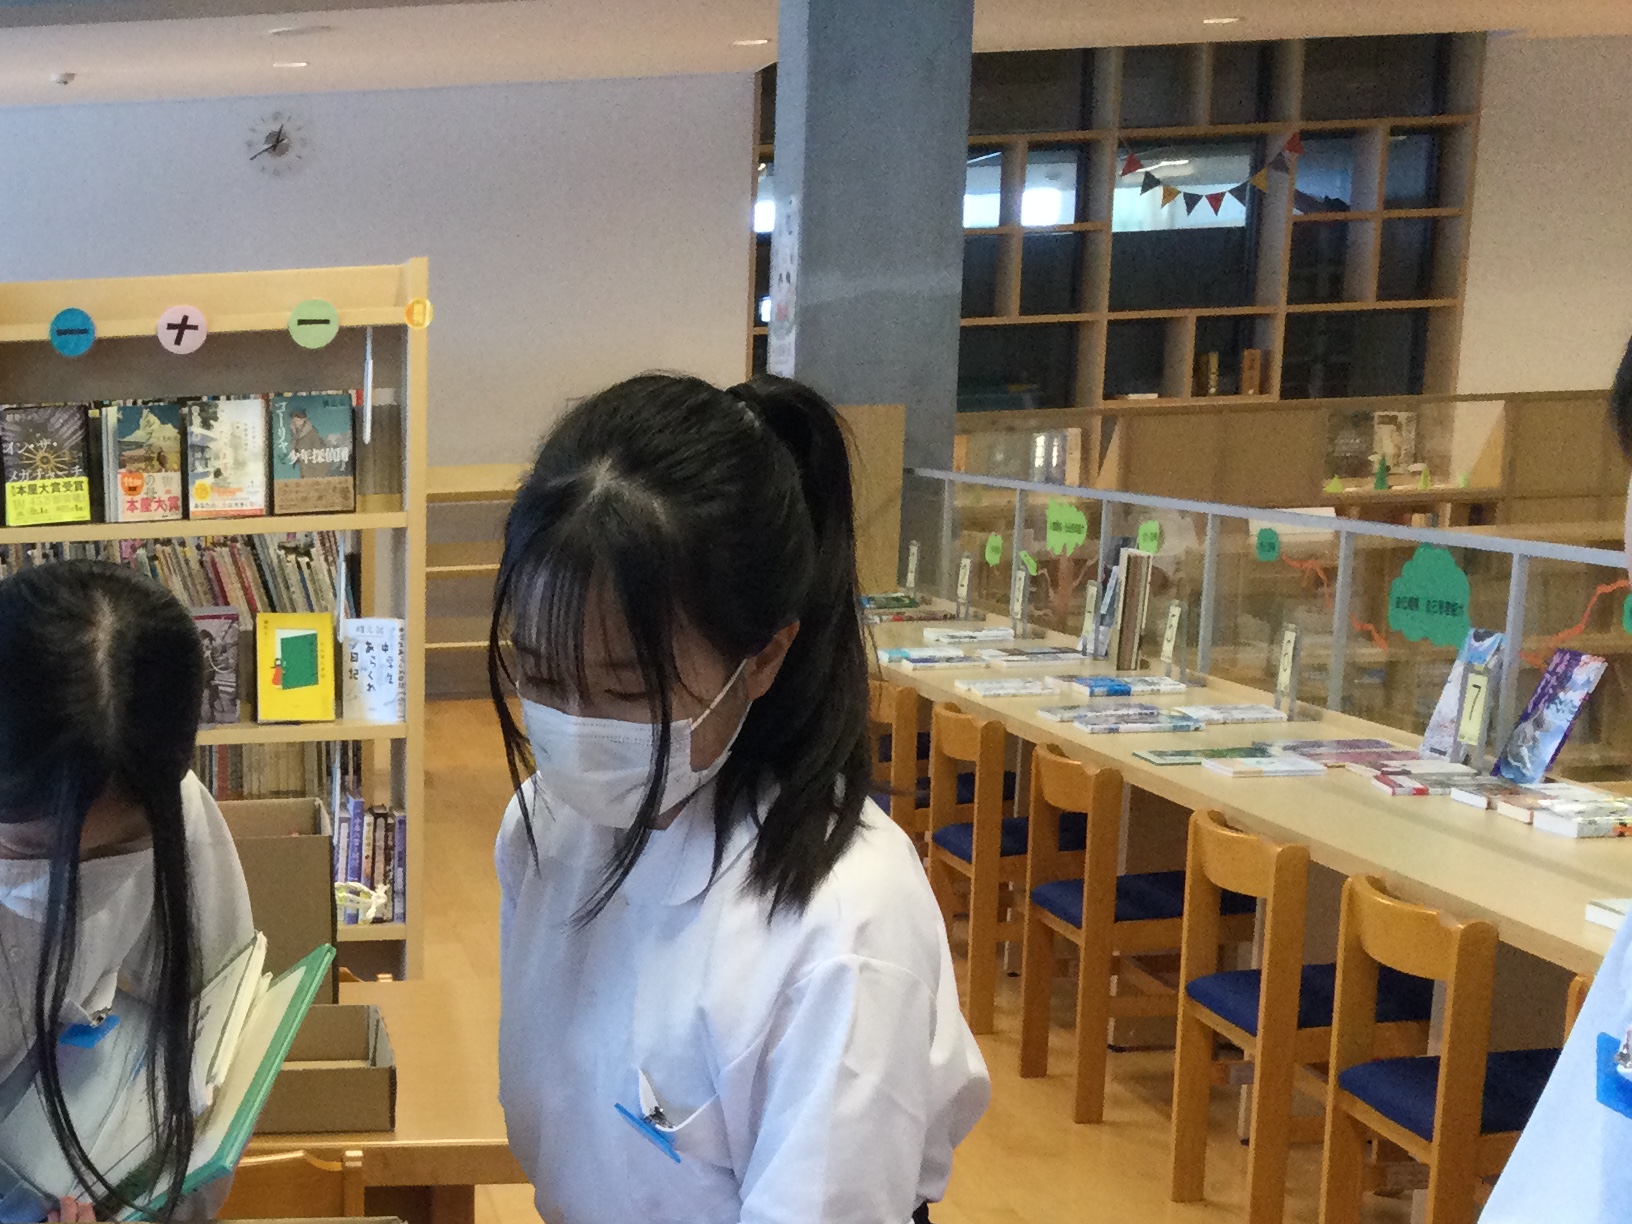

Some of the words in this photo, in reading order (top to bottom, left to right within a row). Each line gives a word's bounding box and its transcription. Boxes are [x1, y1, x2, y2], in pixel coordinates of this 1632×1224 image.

[165, 314, 200, 346] ナ
[126, 495, 181, 513] 本屋大賞
